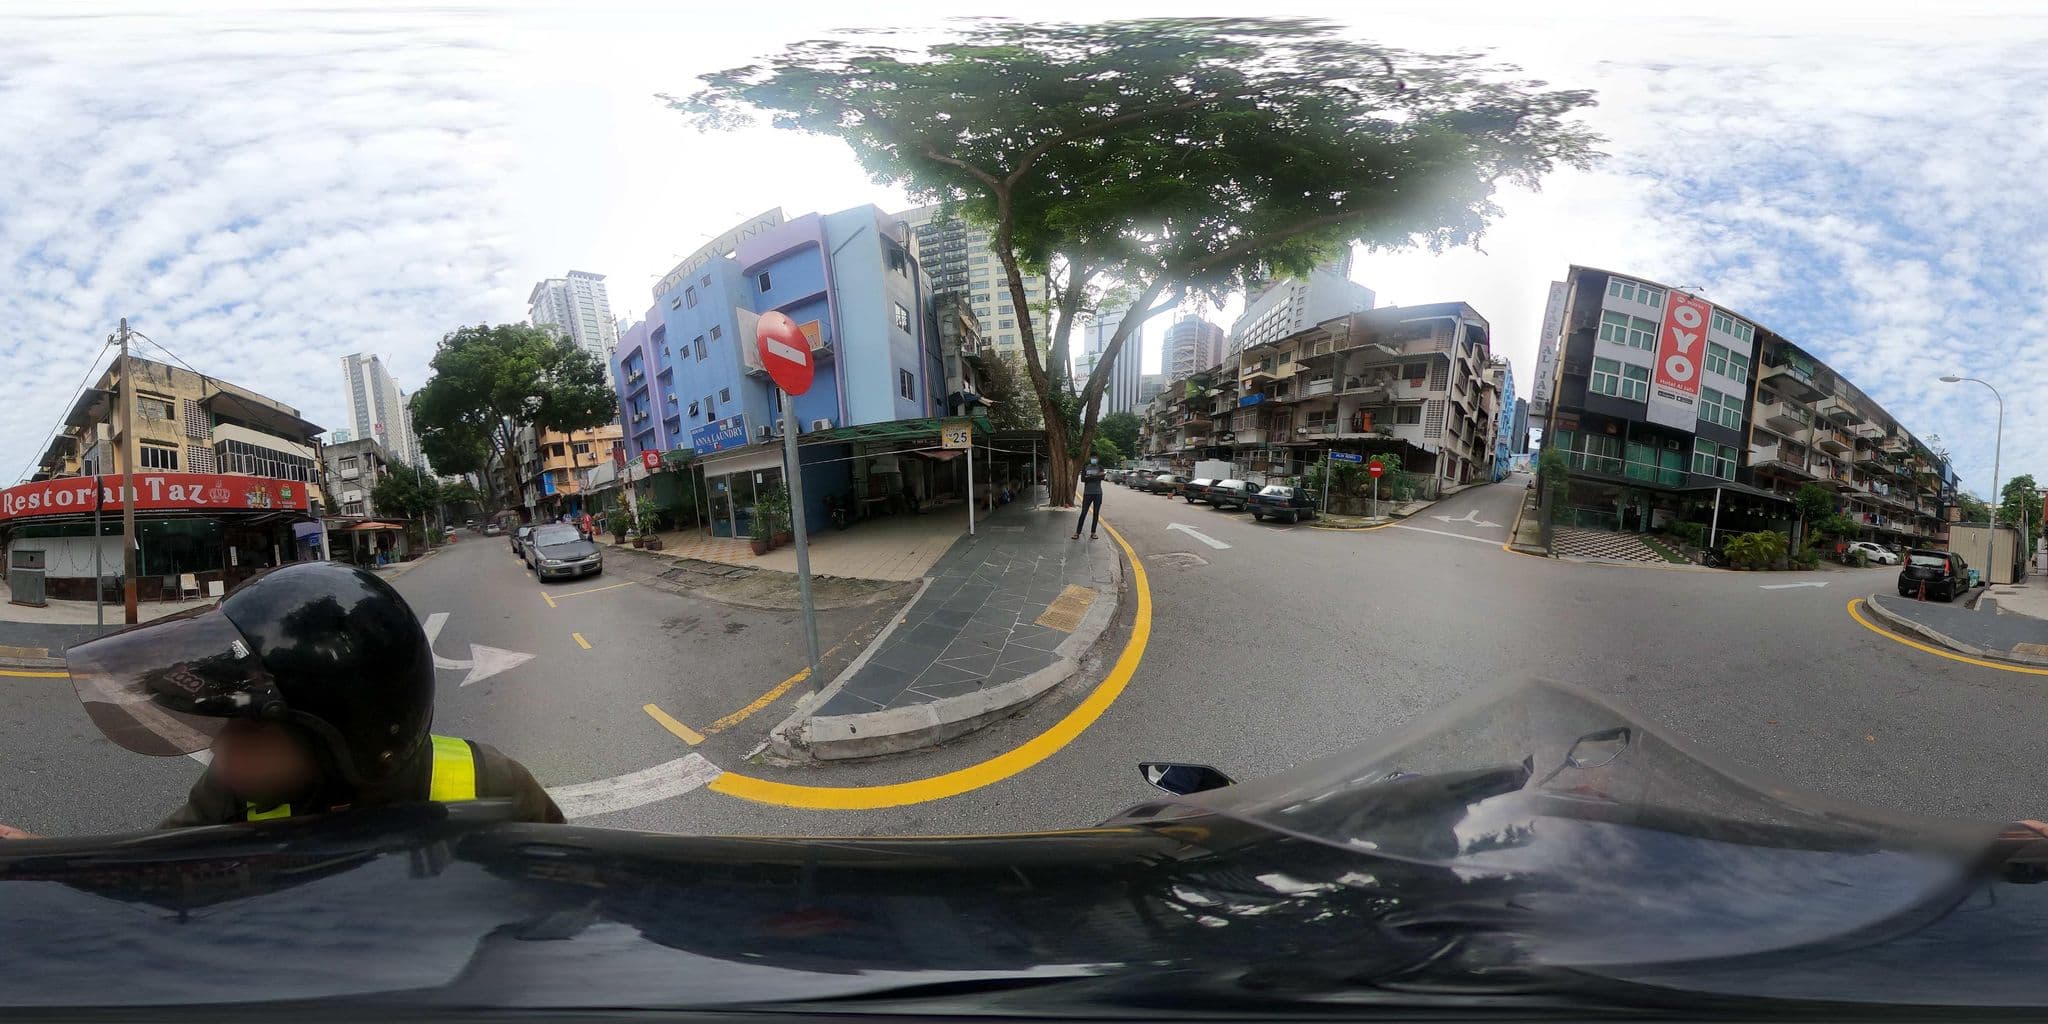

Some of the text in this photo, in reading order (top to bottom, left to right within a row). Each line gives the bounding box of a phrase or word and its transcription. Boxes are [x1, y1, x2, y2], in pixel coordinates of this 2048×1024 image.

[735, 215, 777, 244] INN
[1542, 345, 1553, 363] AL
[1665, 305, 1703, 382] OYO
[711, 426, 743, 442] LAUNDRY
[953, 432, 967, 443] 25
[145, 476, 209, 504] Taz
